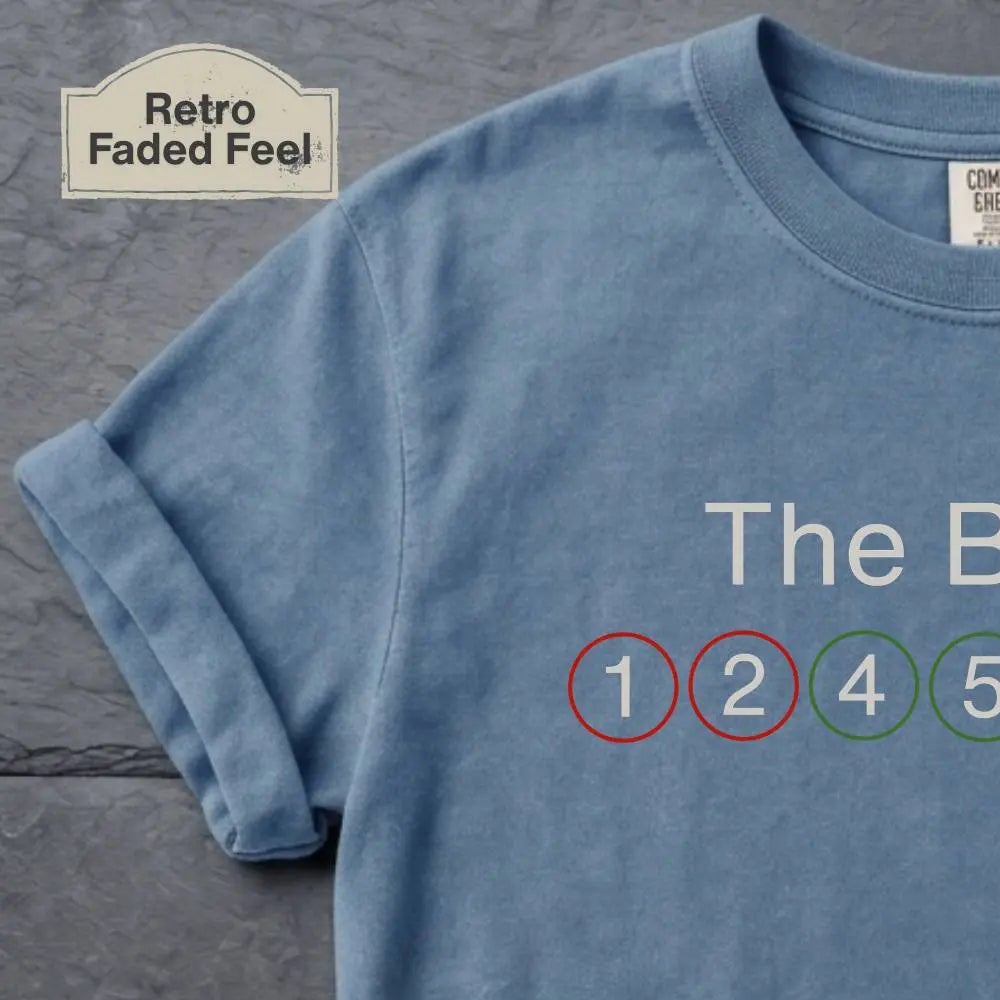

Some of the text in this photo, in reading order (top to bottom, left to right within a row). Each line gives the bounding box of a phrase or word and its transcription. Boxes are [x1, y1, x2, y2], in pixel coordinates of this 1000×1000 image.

[704, 501, 905, 588] The
[604, 655, 631, 718] 1
[722, 652, 767, 717] 2
[837, 652, 886, 717] 4
